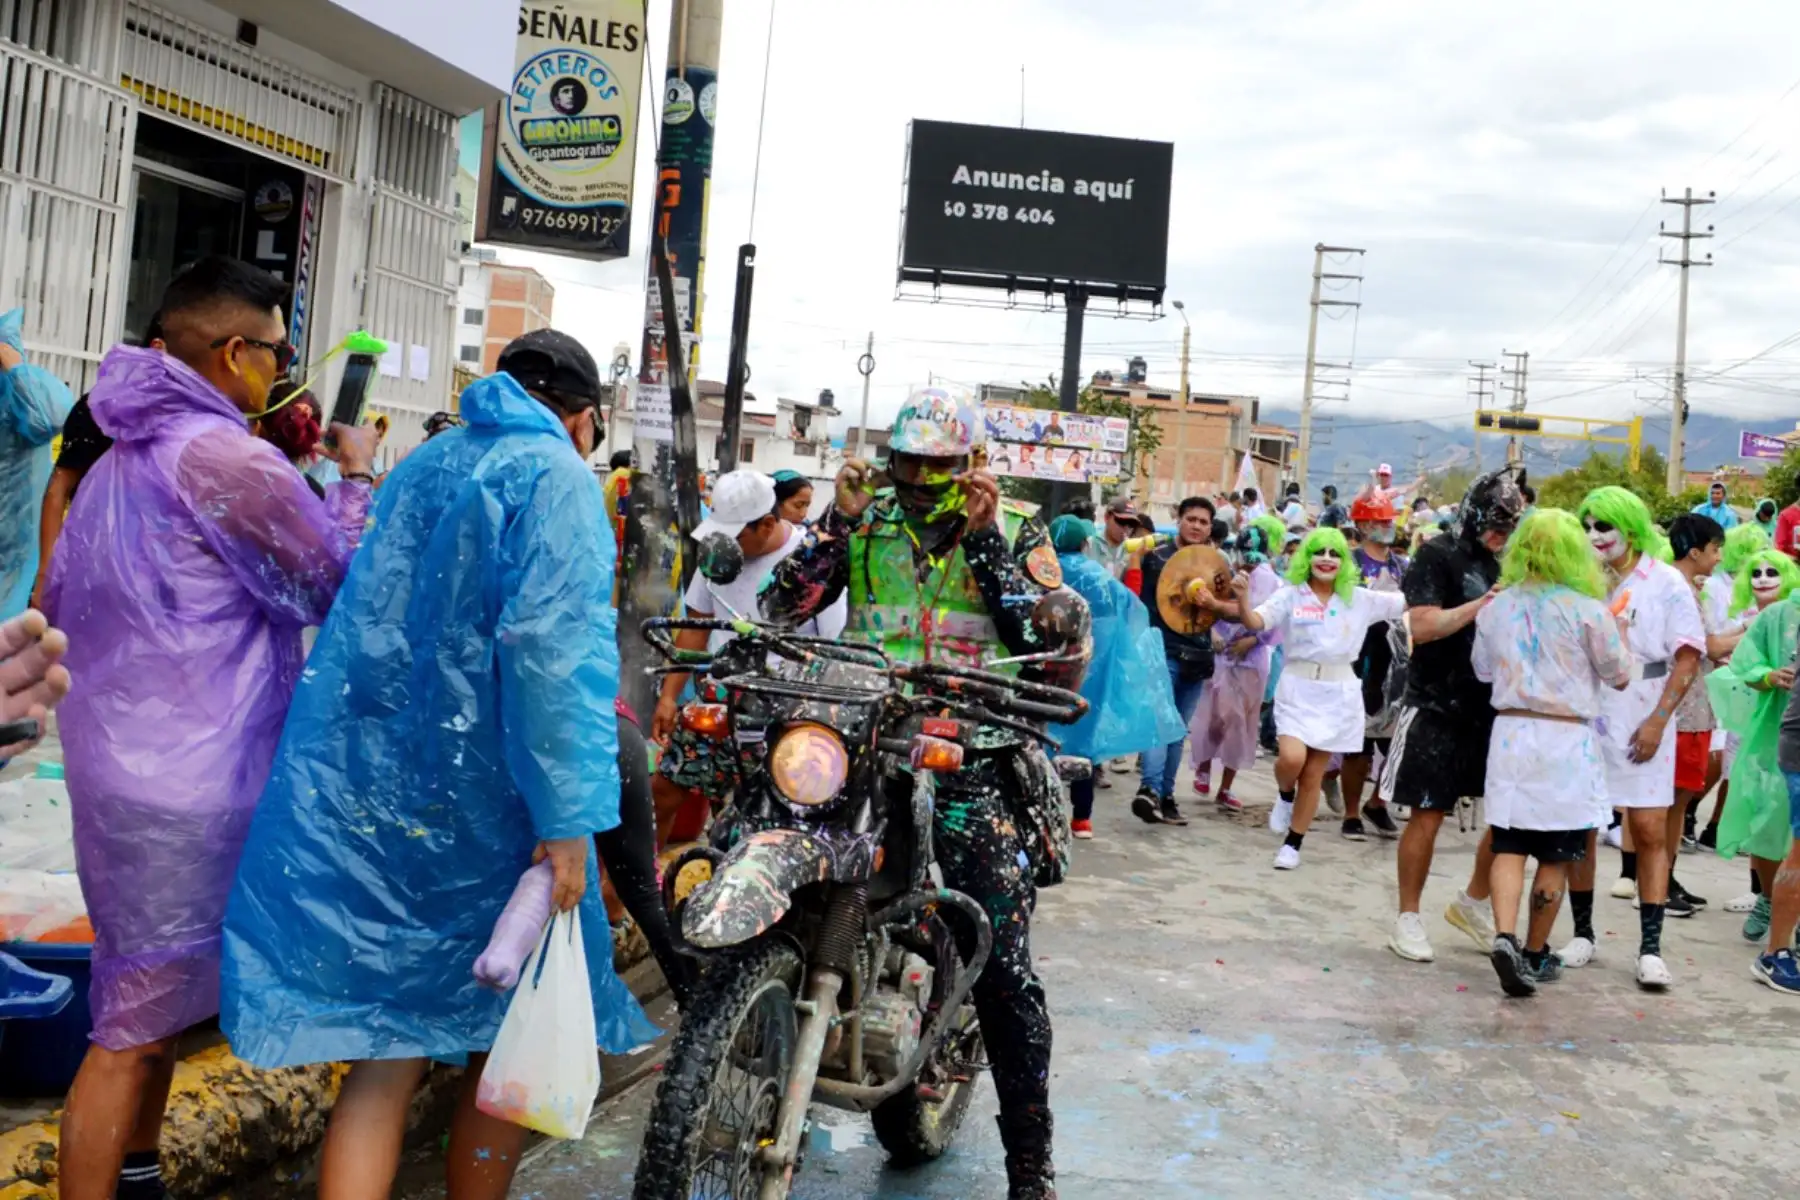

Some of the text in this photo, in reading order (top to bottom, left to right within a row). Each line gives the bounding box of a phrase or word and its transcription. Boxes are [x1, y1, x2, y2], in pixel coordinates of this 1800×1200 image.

[517, 4, 639, 52] SEÑALES
[513, 54, 619, 114] LETREROS
[951, 164, 1135, 202] Anuncia aquí
[971, 203, 1009, 222] 378
[1014, 207, 1056, 226] 404
